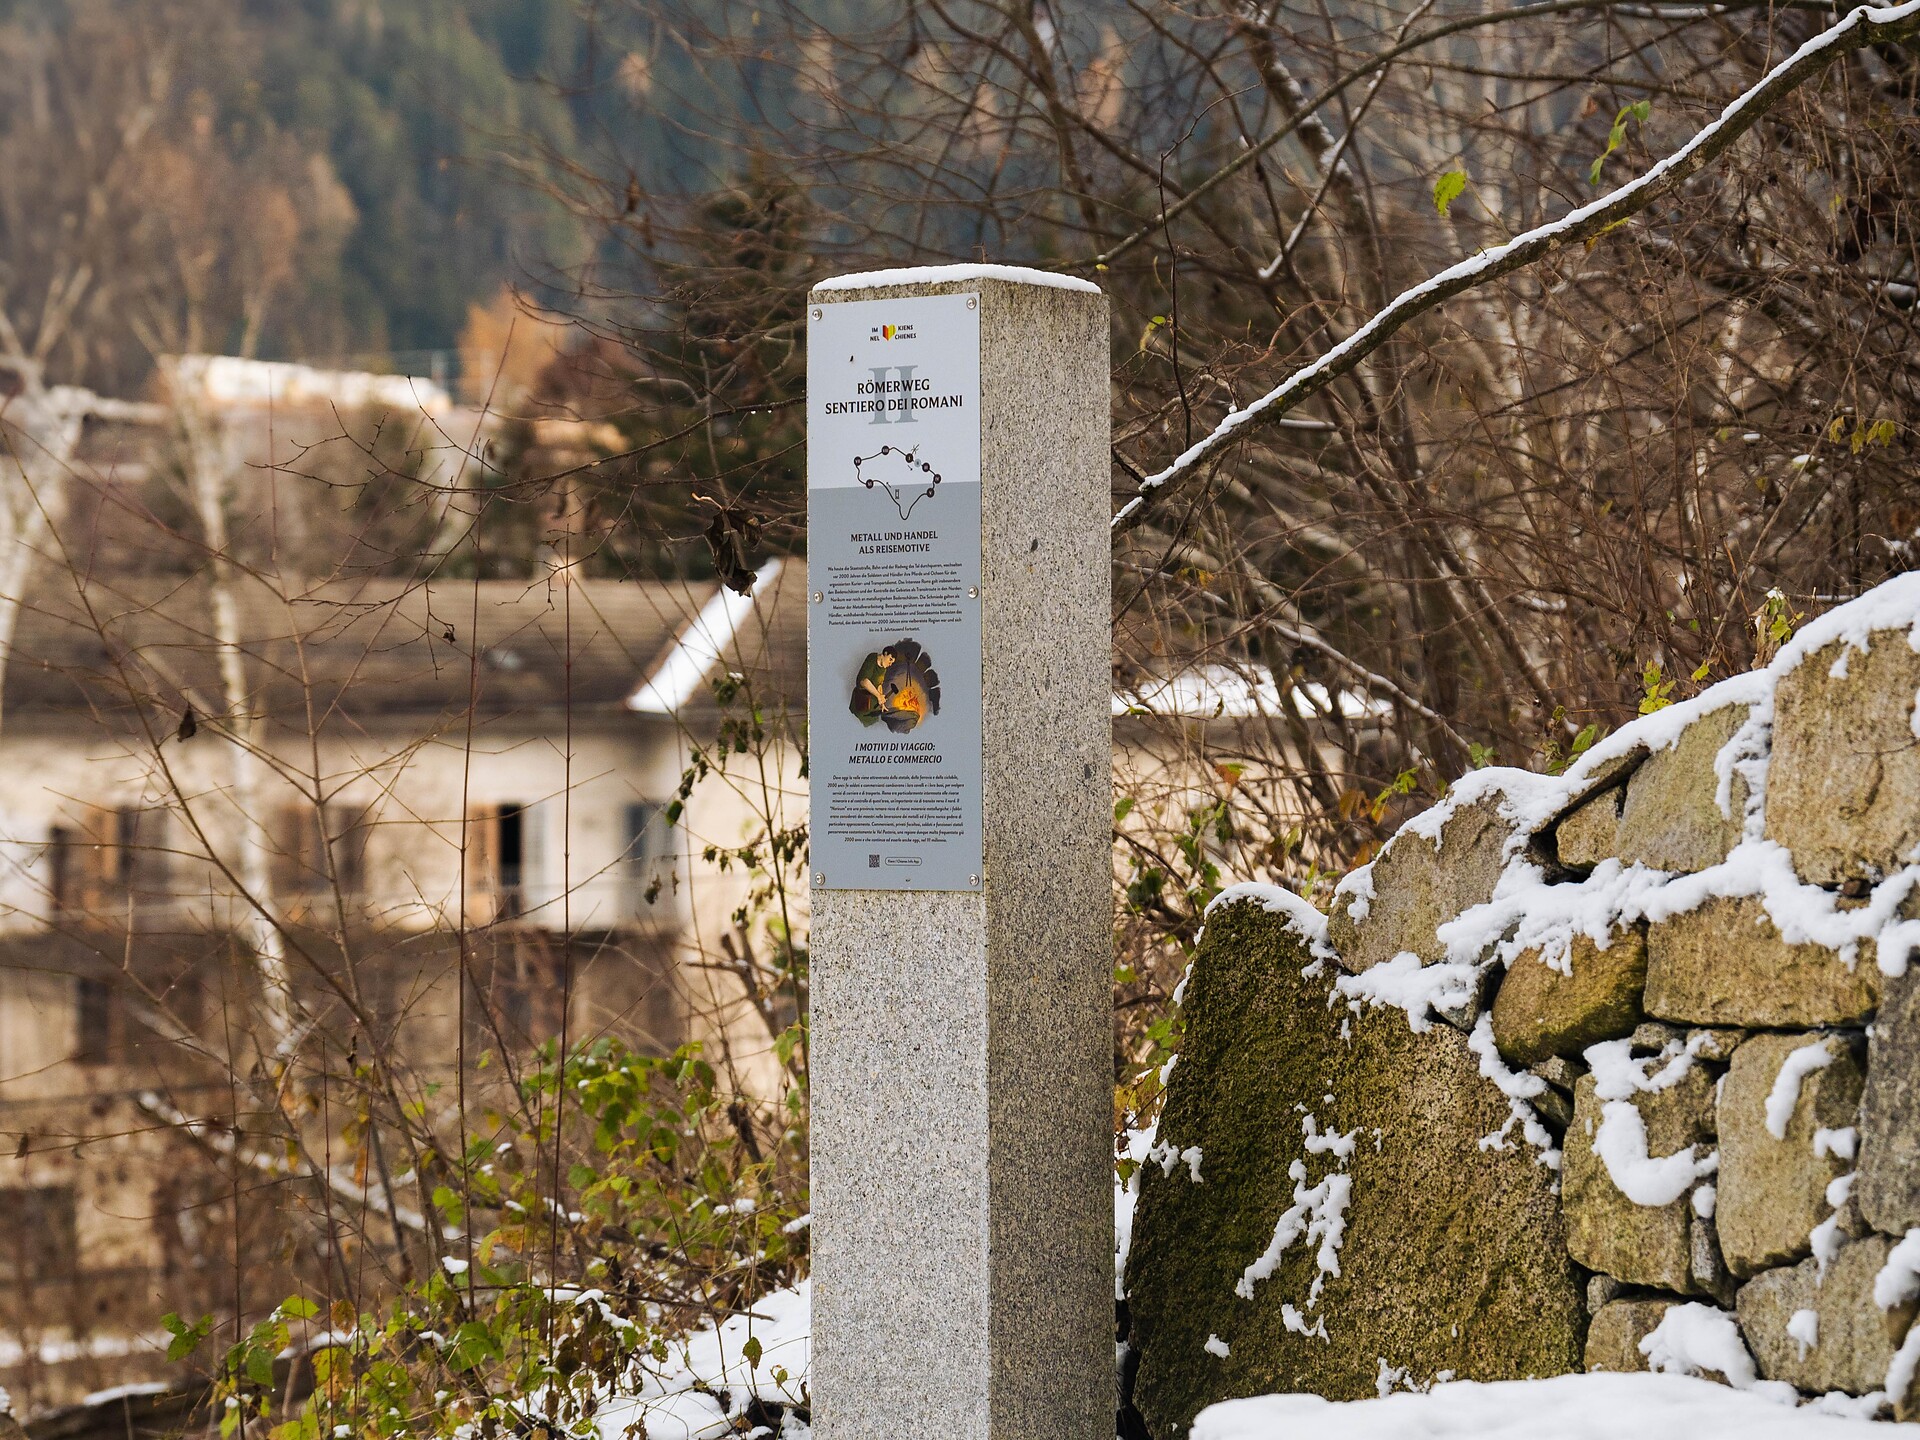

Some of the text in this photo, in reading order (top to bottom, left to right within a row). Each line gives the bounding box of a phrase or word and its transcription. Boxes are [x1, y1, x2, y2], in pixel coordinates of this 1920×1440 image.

[857, 378, 930, 394] RÖMERWEG
[825, 395, 963, 414] SENTIERO DEI ROMANI
[851, 531, 938, 542] METALL UND HANDEL
[859, 544, 930, 554] ALS REISEMOTIVE
[855, 742, 935, 751] I MOTIVI DI VIAGGIO:
[849, 755, 942, 764] METALLO E COMMERCIO
